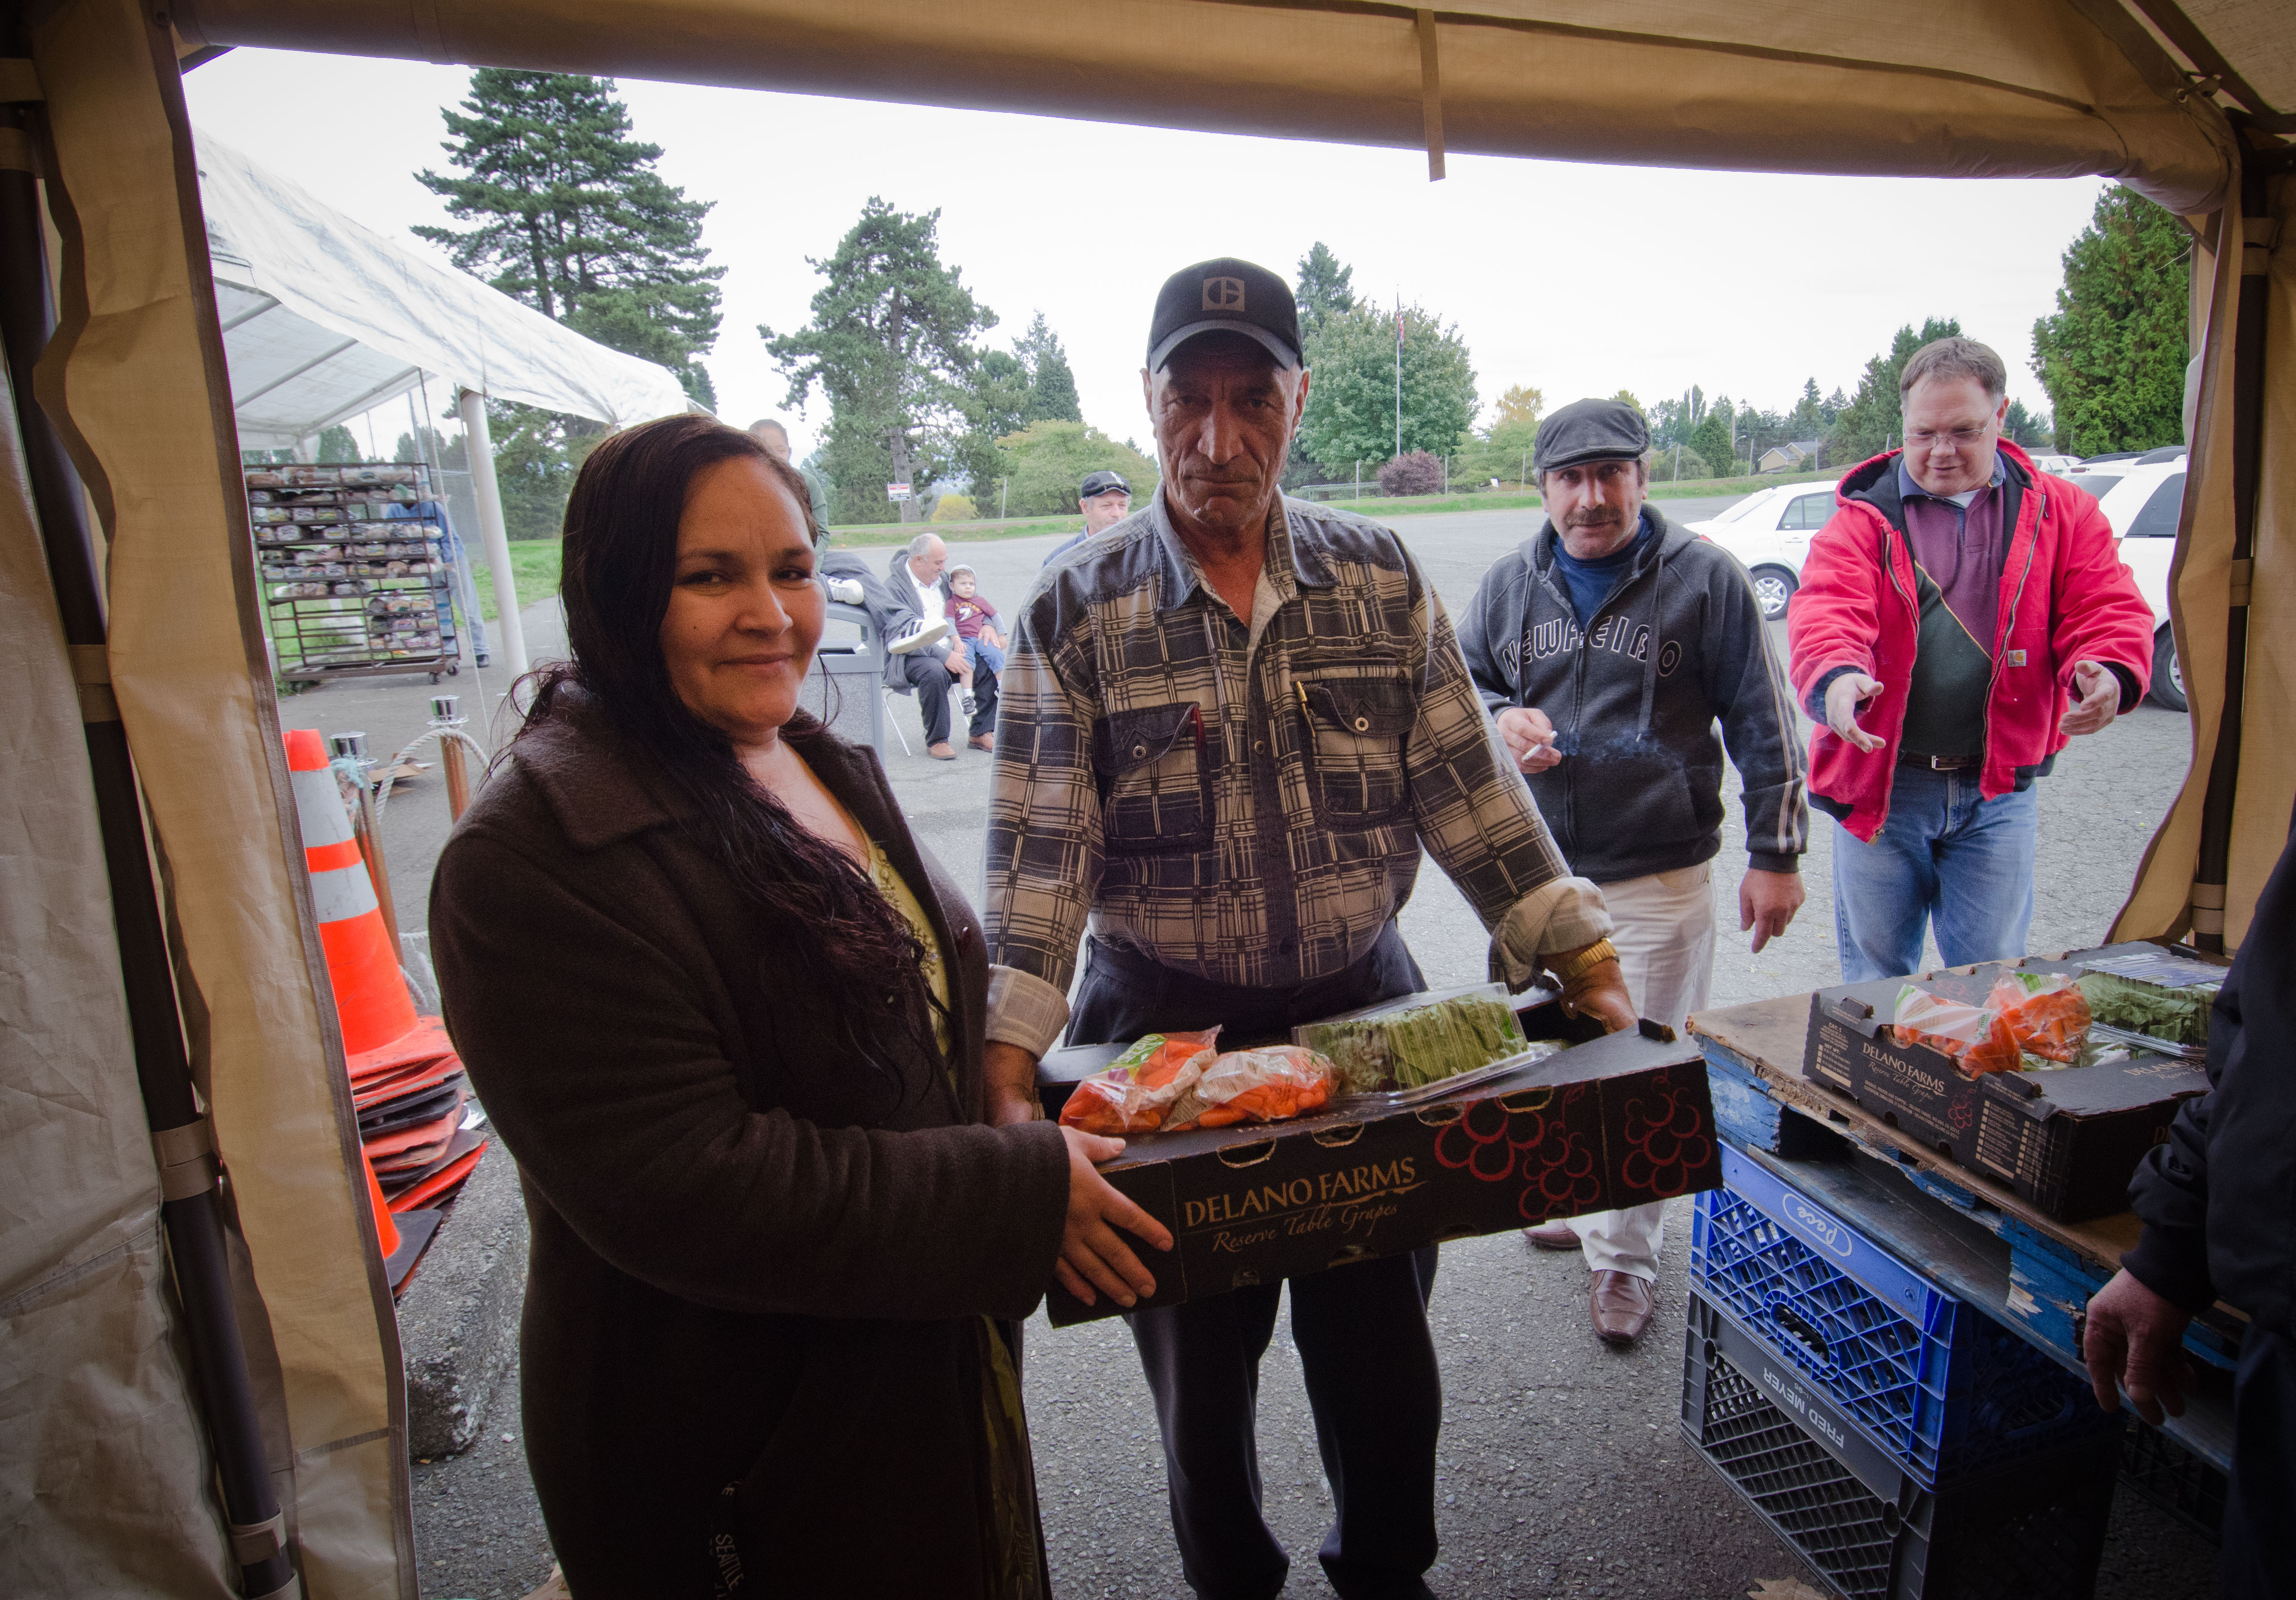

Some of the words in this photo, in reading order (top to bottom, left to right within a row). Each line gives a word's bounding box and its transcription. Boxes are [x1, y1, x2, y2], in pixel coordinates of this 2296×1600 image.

[959, 607, 971, 621] 7
[1863, 1042, 1906, 1073] DELANO
[1907, 1065, 1945, 1092] FARMS
[1868, 1061, 1891, 1078] Reserve
[1892, 1073, 1910, 1088] Table
[1912, 1084, 1934, 1102] Grapes
[2122, 1060, 2190, 1076] DELANO
[1184, 1178, 1312, 1227] DELANO
[1319, 1157, 1416, 1200] FARMS
[1212, 1226, 1277, 1253] Reserve
[1284, 1206, 1333, 1236] Table
[1341, 1204, 1398, 1237] Grapes
[1764, 1367, 1805, 1415] MEYER
[1809, 1408, 1844, 1449] FRED
